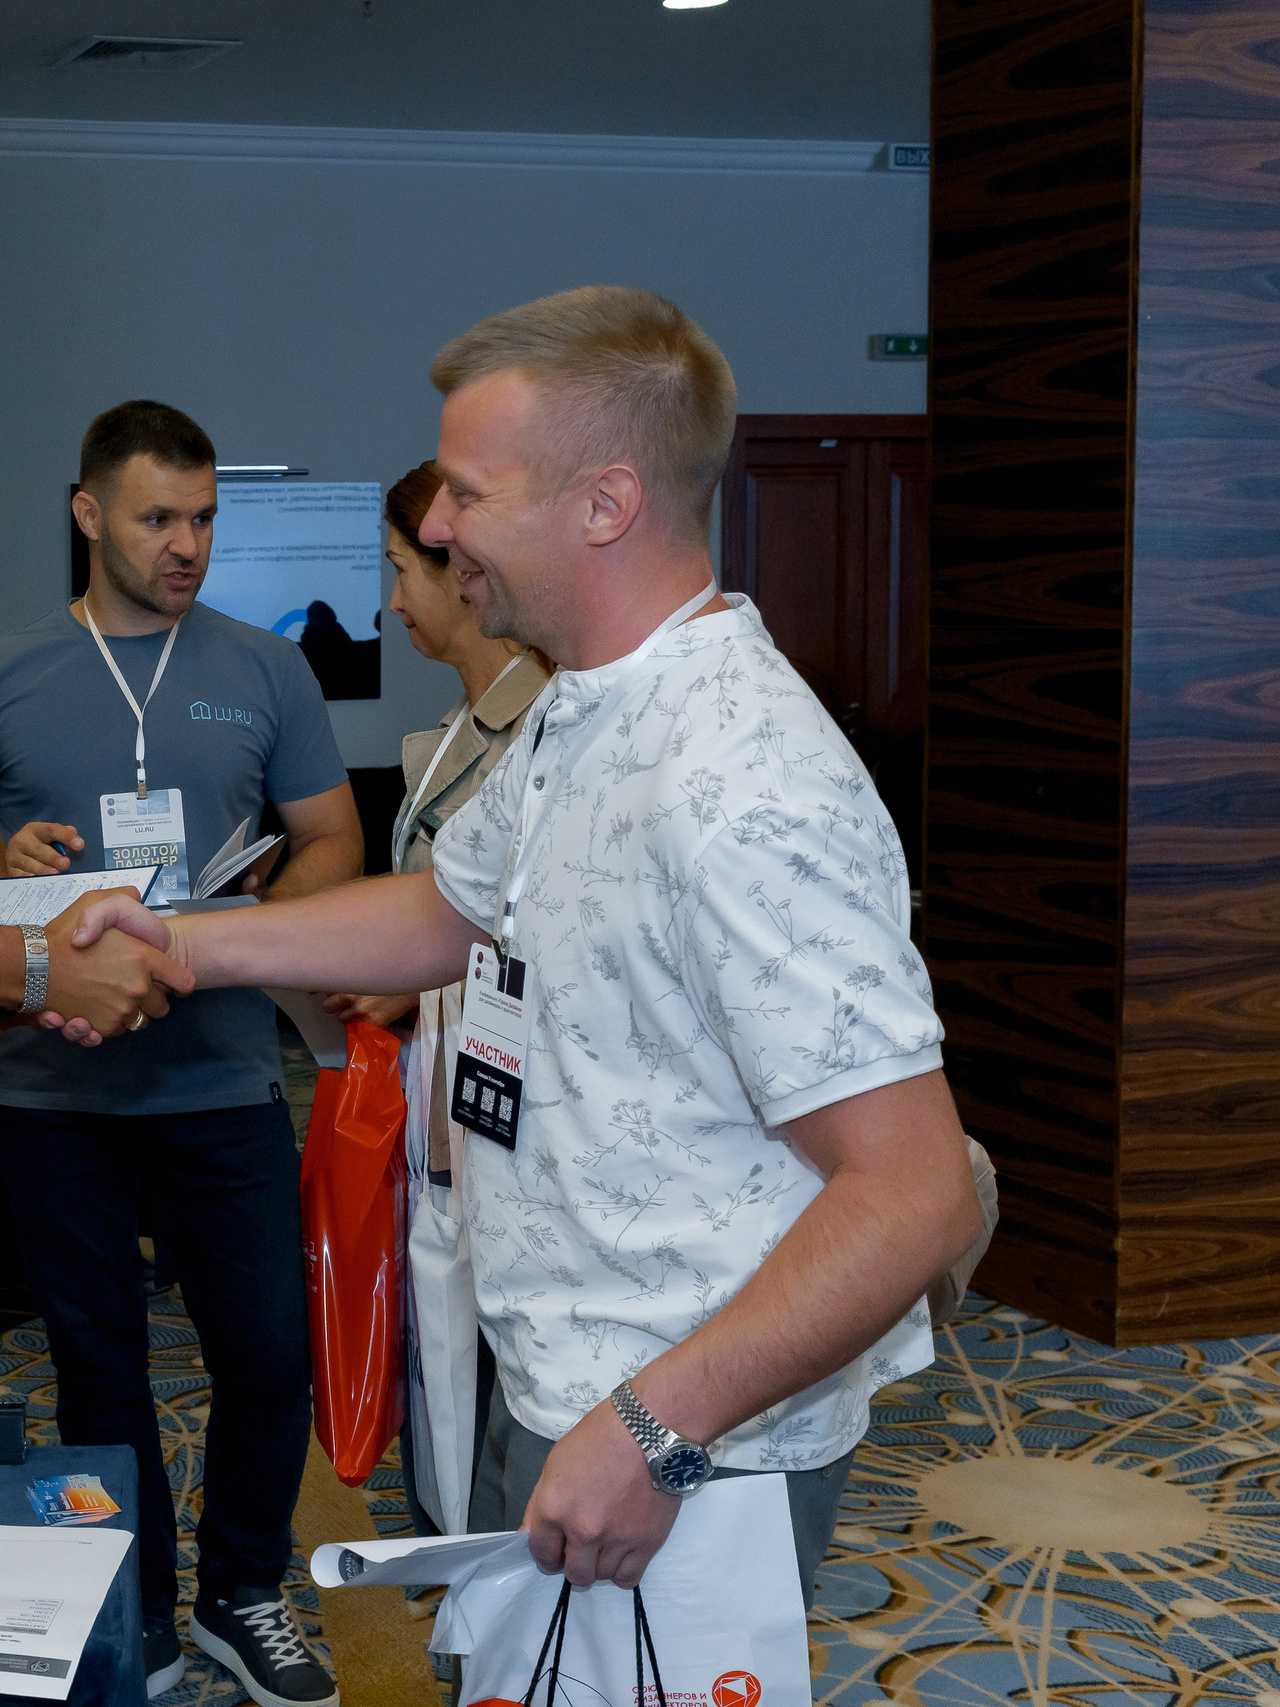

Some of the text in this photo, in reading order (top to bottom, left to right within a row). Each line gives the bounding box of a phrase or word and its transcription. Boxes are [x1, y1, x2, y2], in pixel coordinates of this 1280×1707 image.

[897, 150, 929, 164] ВЫХ
[215, 707, 252, 725] LU.RU
[112, 842, 178, 860] ЗОЛОТОЙ
[465, 1035, 522, 1075] УЧАСТНИК
[346, 1553, 354, 1579] РАНИ
[634, 1693, 697, 1704] ДИЗАНЕРОВ
